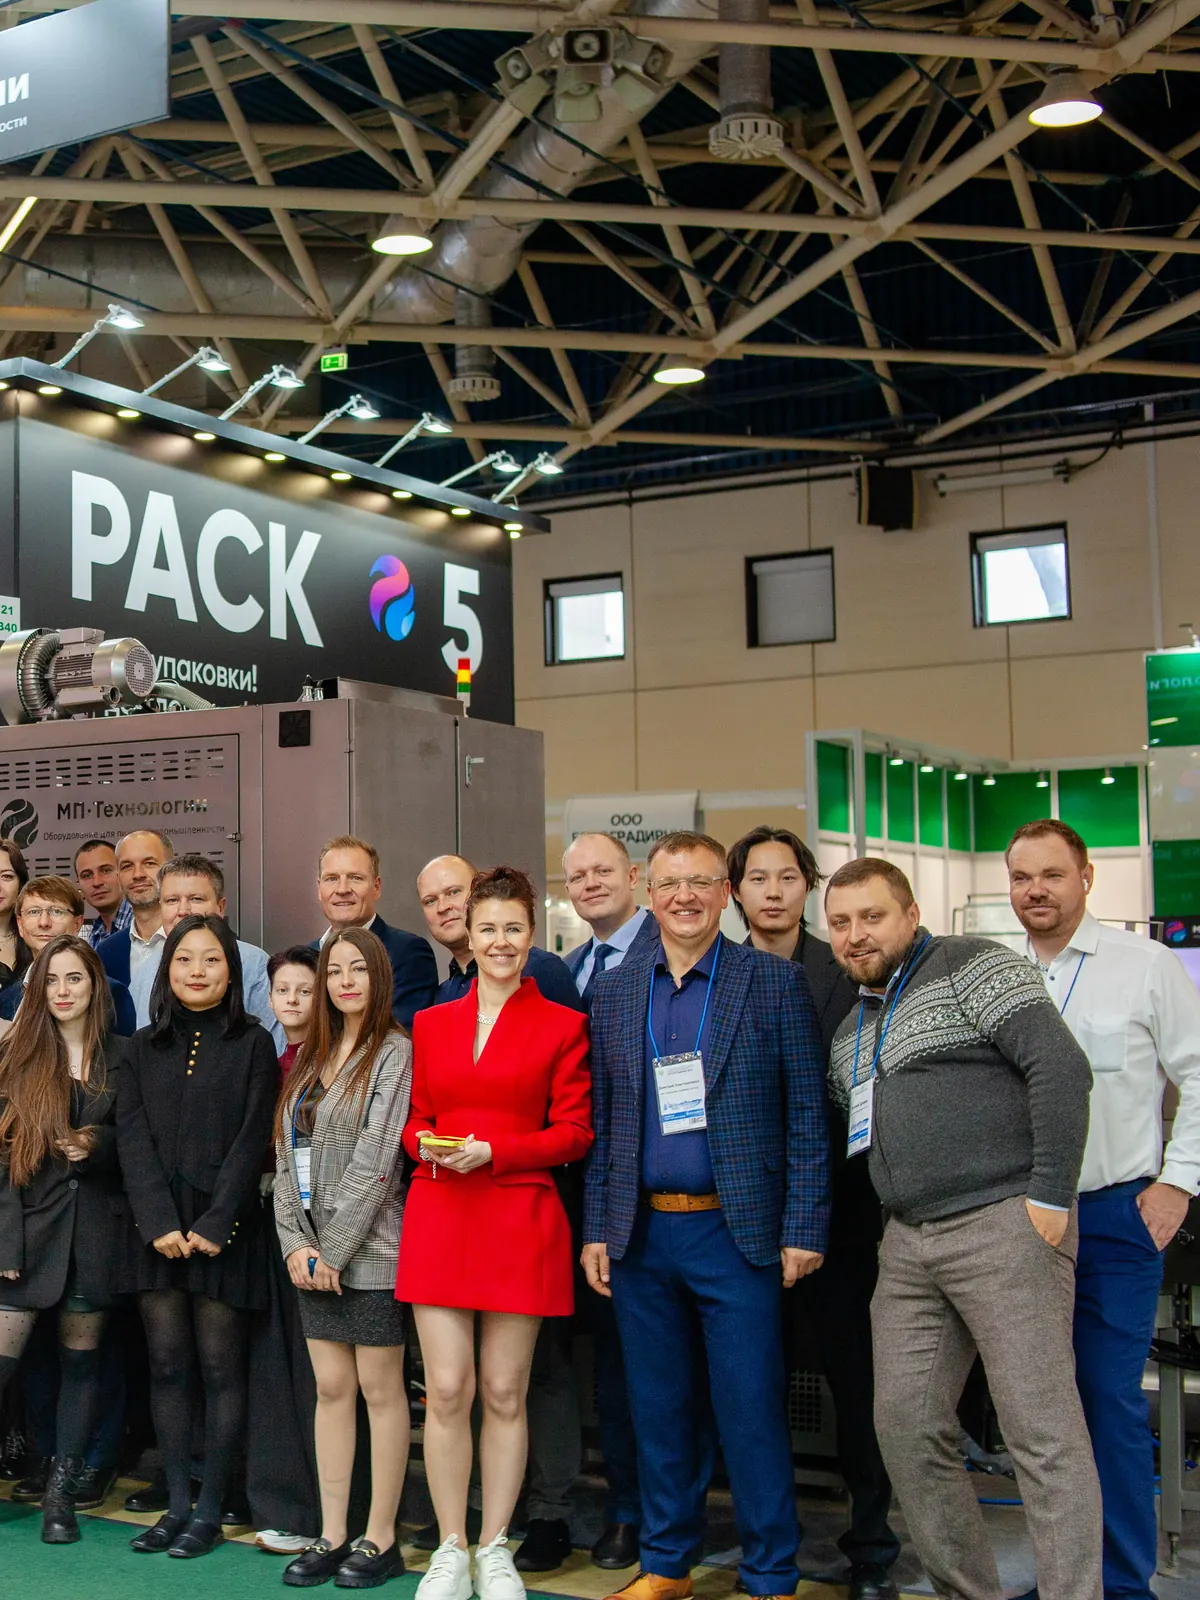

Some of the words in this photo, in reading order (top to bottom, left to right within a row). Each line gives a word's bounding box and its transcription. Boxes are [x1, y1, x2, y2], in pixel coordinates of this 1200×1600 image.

[71, 470, 324, 647] PACK
[441, 562, 483, 676] 5
[1, 605, 13, 615] 21
[611, 813, 643, 827] ООО
[43, 830, 99, 842] Оборудование
[100, 829, 115, 840] для
